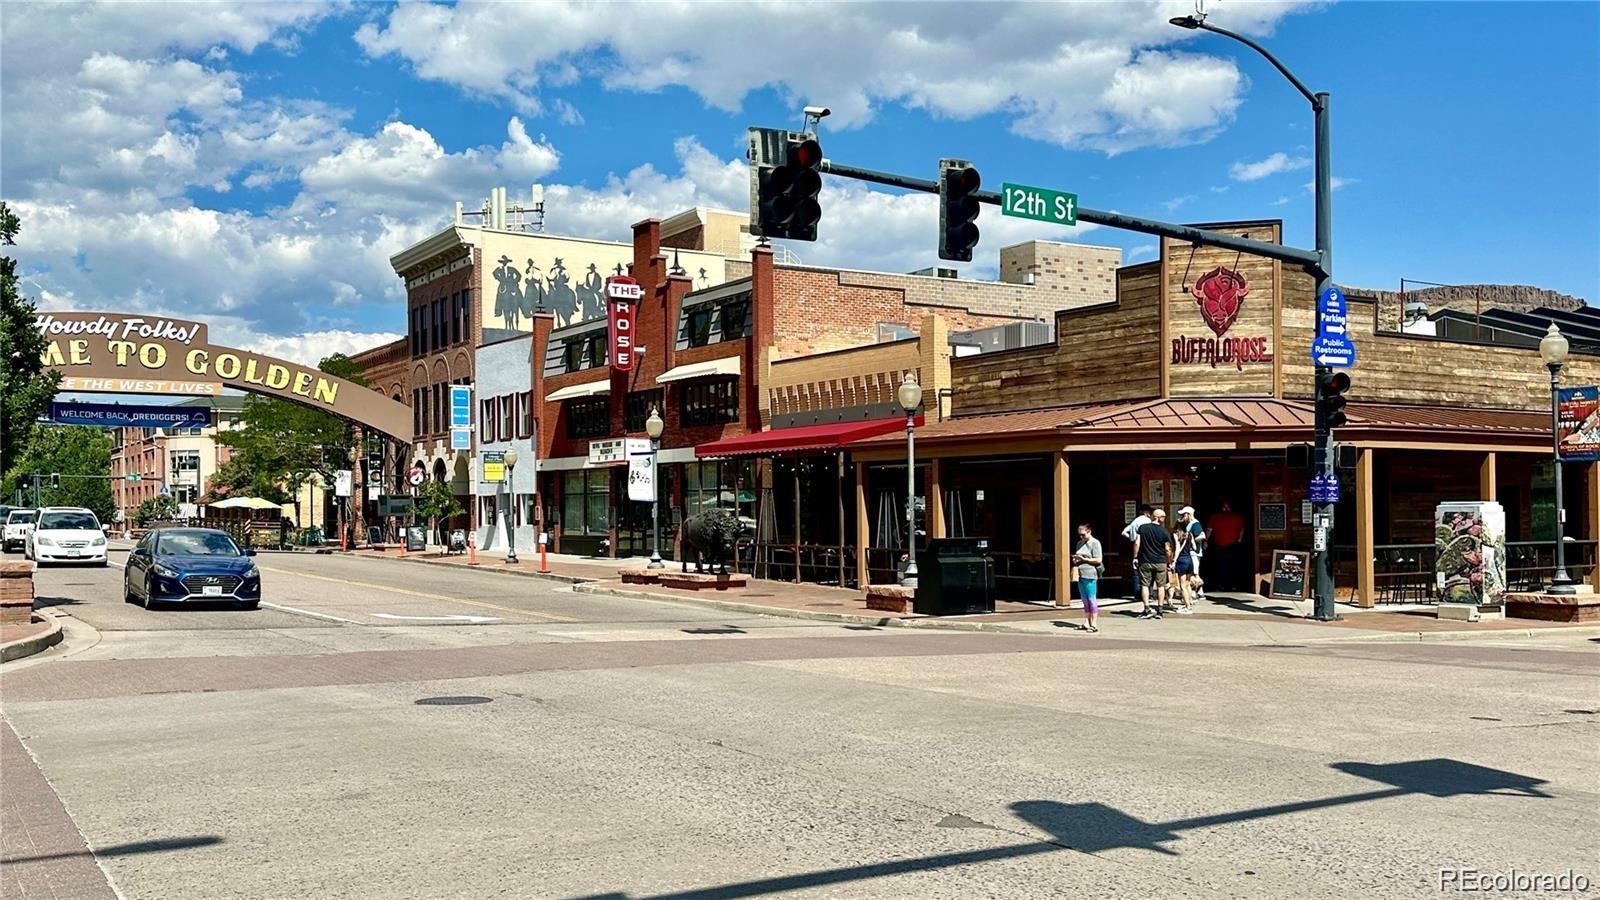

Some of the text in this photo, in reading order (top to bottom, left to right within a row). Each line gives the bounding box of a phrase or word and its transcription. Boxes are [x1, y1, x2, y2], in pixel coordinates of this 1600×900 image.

[1005, 187, 1074, 221] 12th St
[612, 286, 638, 295] THE
[1321, 313, 1346, 325] Parking
[35, 314, 200, 345] Howdy Folks!
[616, 302, 630, 365] ROSE
[1323, 338, 1344, 347] Public
[1315, 346, 1352, 355] Restrooms
[108, 340, 167, 369] TO
[185, 349, 340, 406] GOLDEN
[82, 378, 113, 391] THE
[119, 379, 167, 392] WEST
[169, 382, 214, 394] LIVES
[60, 409, 189, 422] WELCOME BACK, OREDIGGERS!
